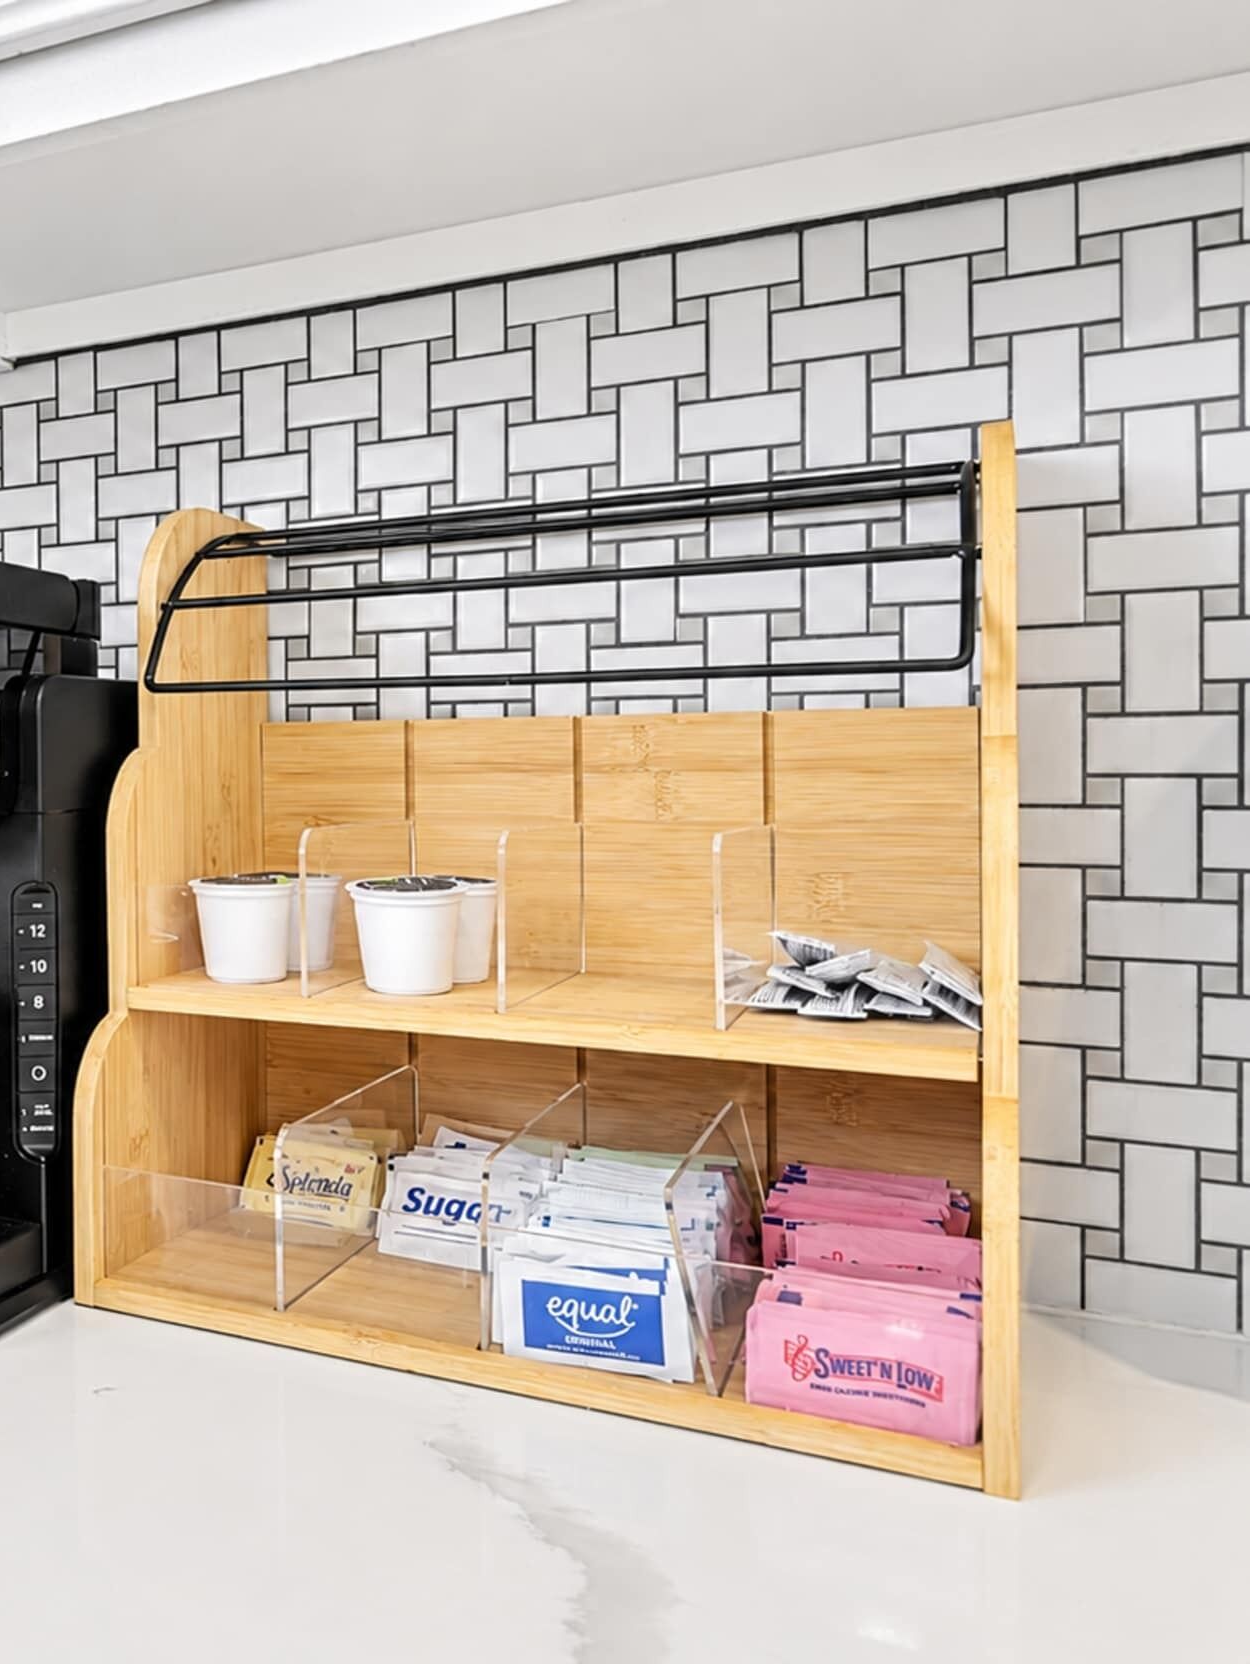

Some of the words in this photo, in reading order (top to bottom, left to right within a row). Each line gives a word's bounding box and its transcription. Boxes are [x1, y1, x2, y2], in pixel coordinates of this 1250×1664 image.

[29, 923, 46, 938] 12
[29, 959, 47, 973] 10
[33, 995, 44, 1009] 8
[546, 1294, 636, 1331] equal
[894, 1361, 934, 1391] LOW
